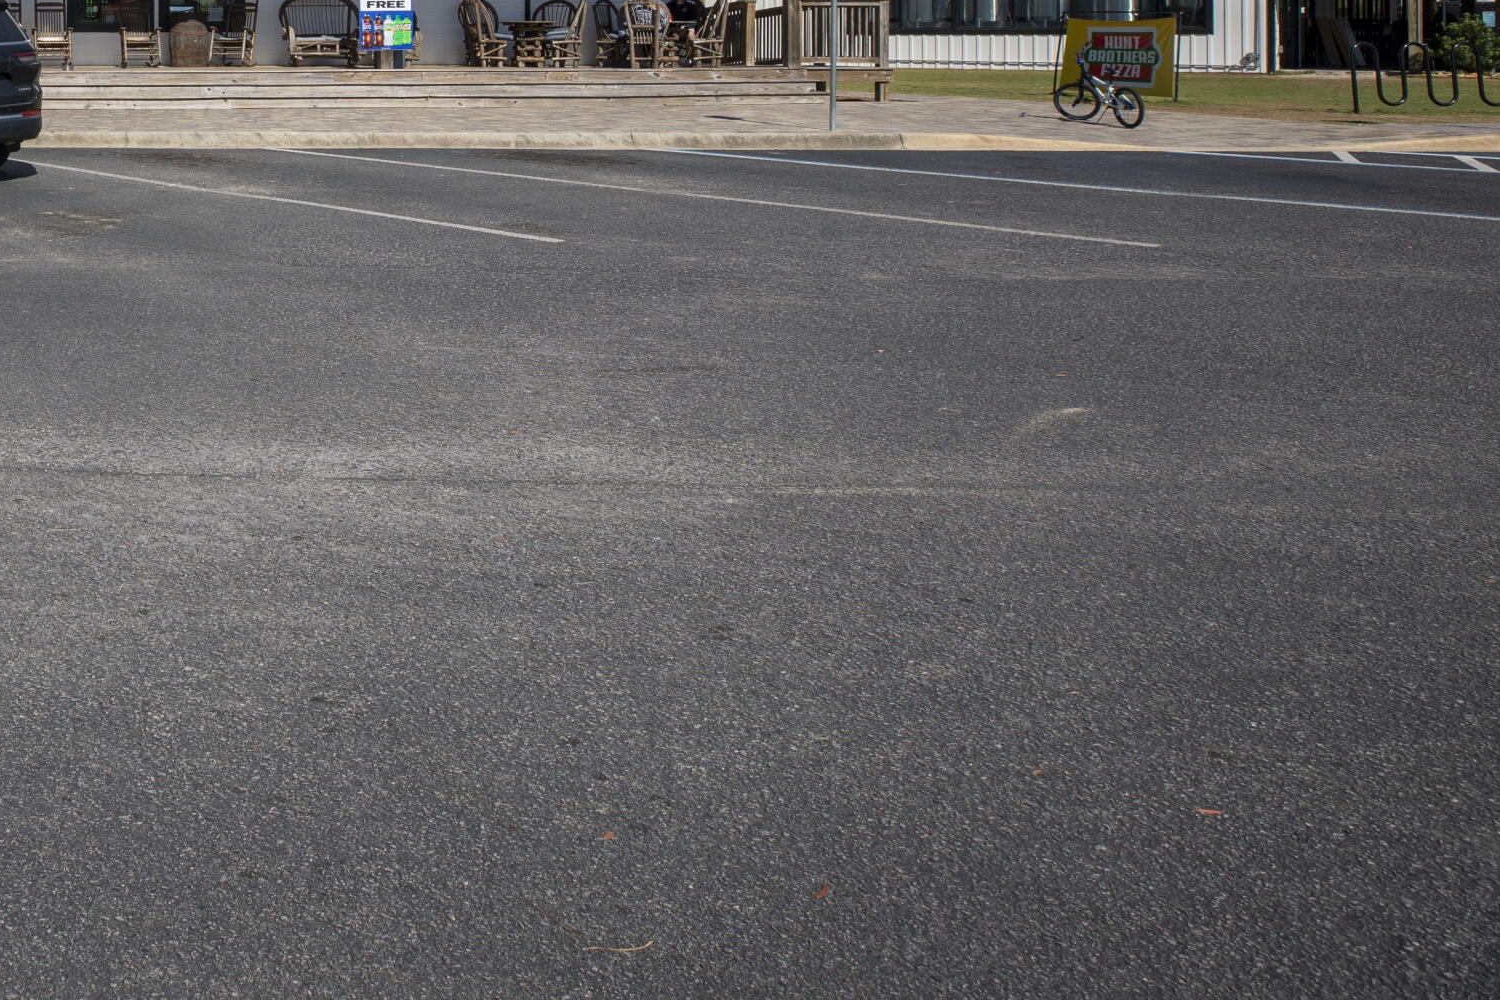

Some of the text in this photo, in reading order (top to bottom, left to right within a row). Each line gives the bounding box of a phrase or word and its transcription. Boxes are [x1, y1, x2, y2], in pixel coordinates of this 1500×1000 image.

[366, 0, 405, 9] FREE
[1103, 36, 1141, 49] HUNT
[1088, 49, 1156, 64] BROTHERS
